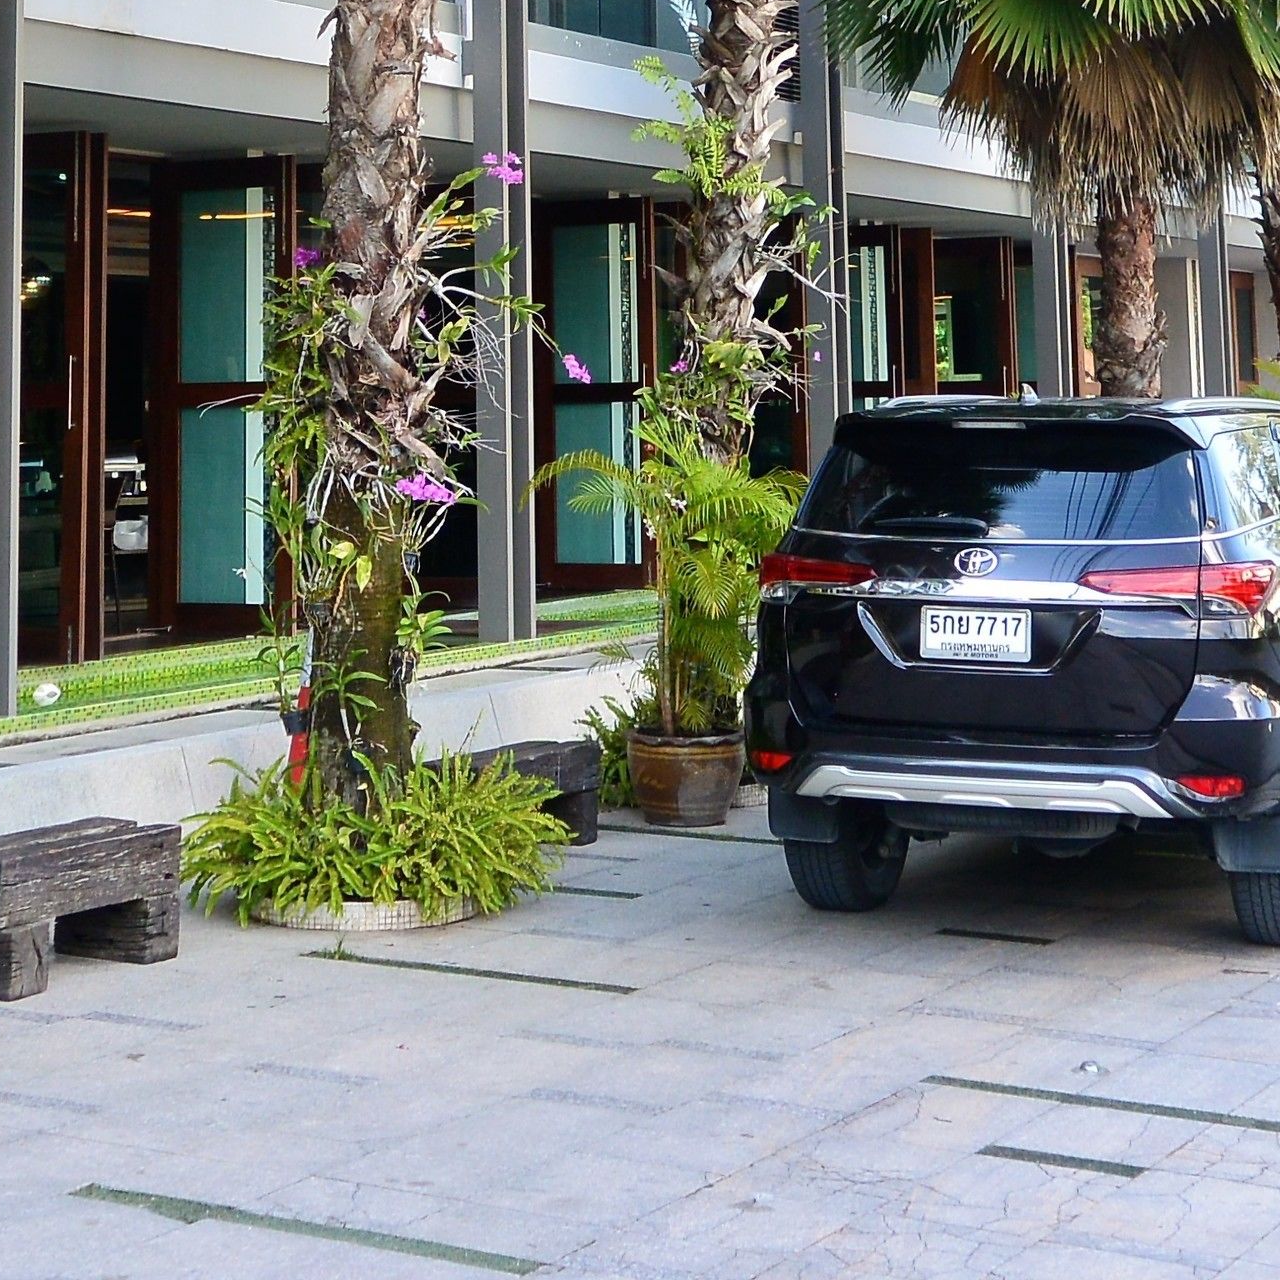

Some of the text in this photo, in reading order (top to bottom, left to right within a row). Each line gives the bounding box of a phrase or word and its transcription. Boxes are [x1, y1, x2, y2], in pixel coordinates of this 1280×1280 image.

[975, 616, 1022, 637] 7717
[940, 642, 1010, 653] กรงเทพมหานคร
